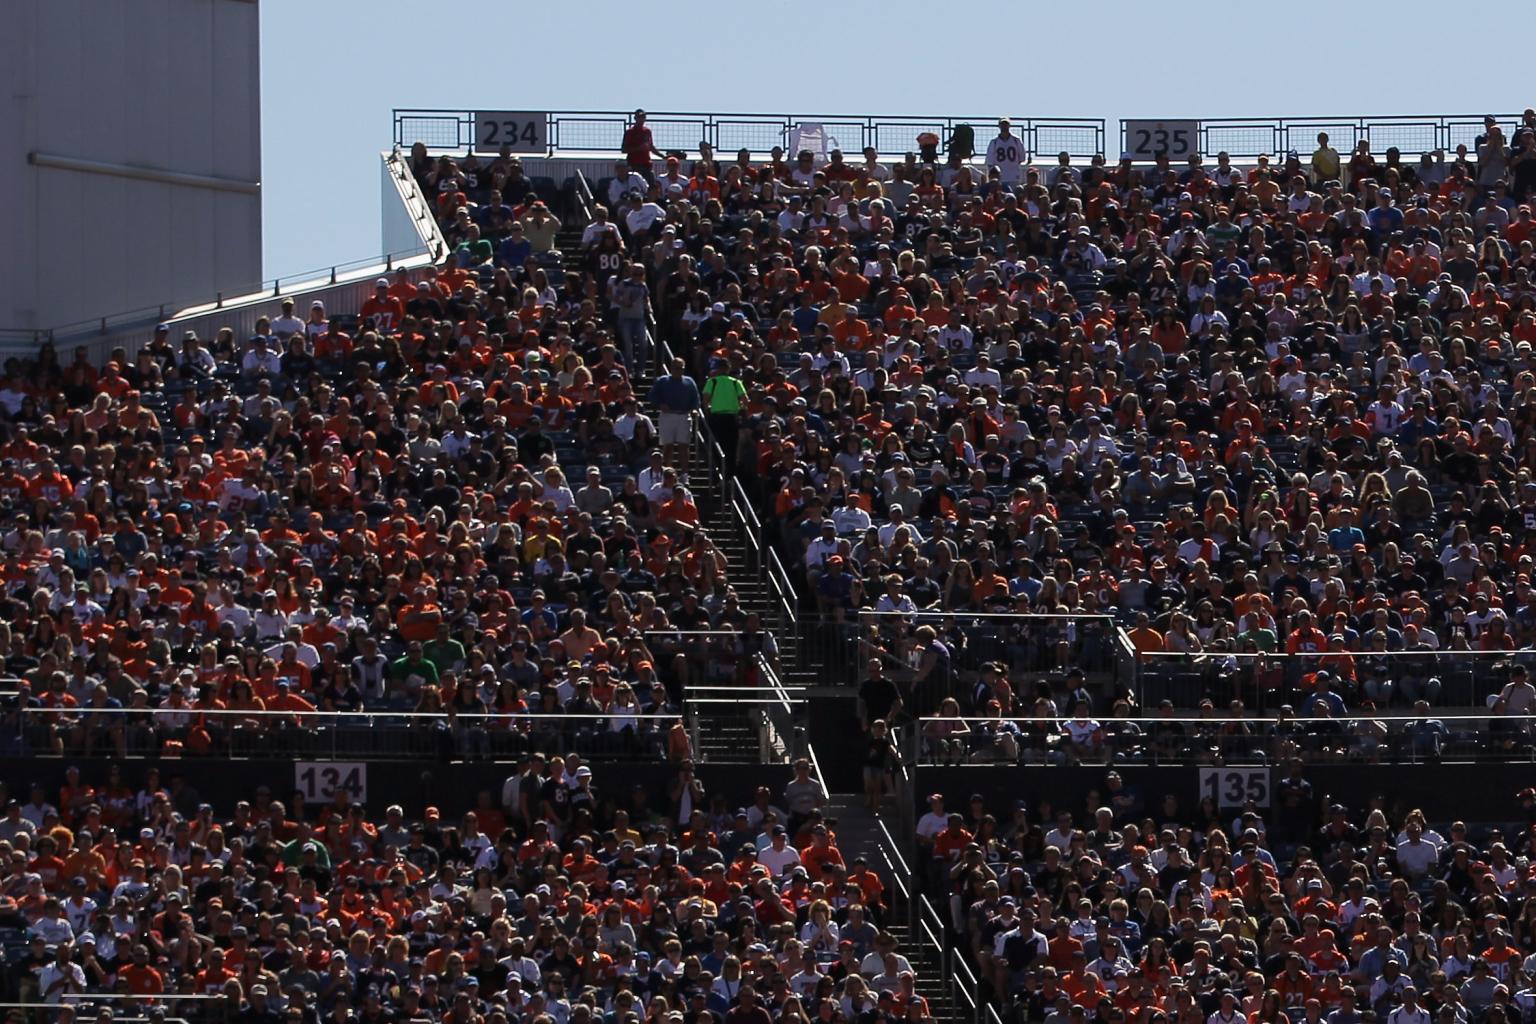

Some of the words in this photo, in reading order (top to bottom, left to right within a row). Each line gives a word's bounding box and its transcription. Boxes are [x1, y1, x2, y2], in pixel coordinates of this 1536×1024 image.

[483, 119, 539, 148] 234
[1135, 129, 1190, 155] 235
[996, 146, 1017, 162] 80
[599, 253, 619, 270] 80
[374, 312, 393, 330] 27
[548, 408, 559, 426] 7
[1383, 413, 1393, 430] 7
[300, 766, 364, 798] 134
[1203, 772, 1267, 803] 135
[75, 914, 86, 928] 7
